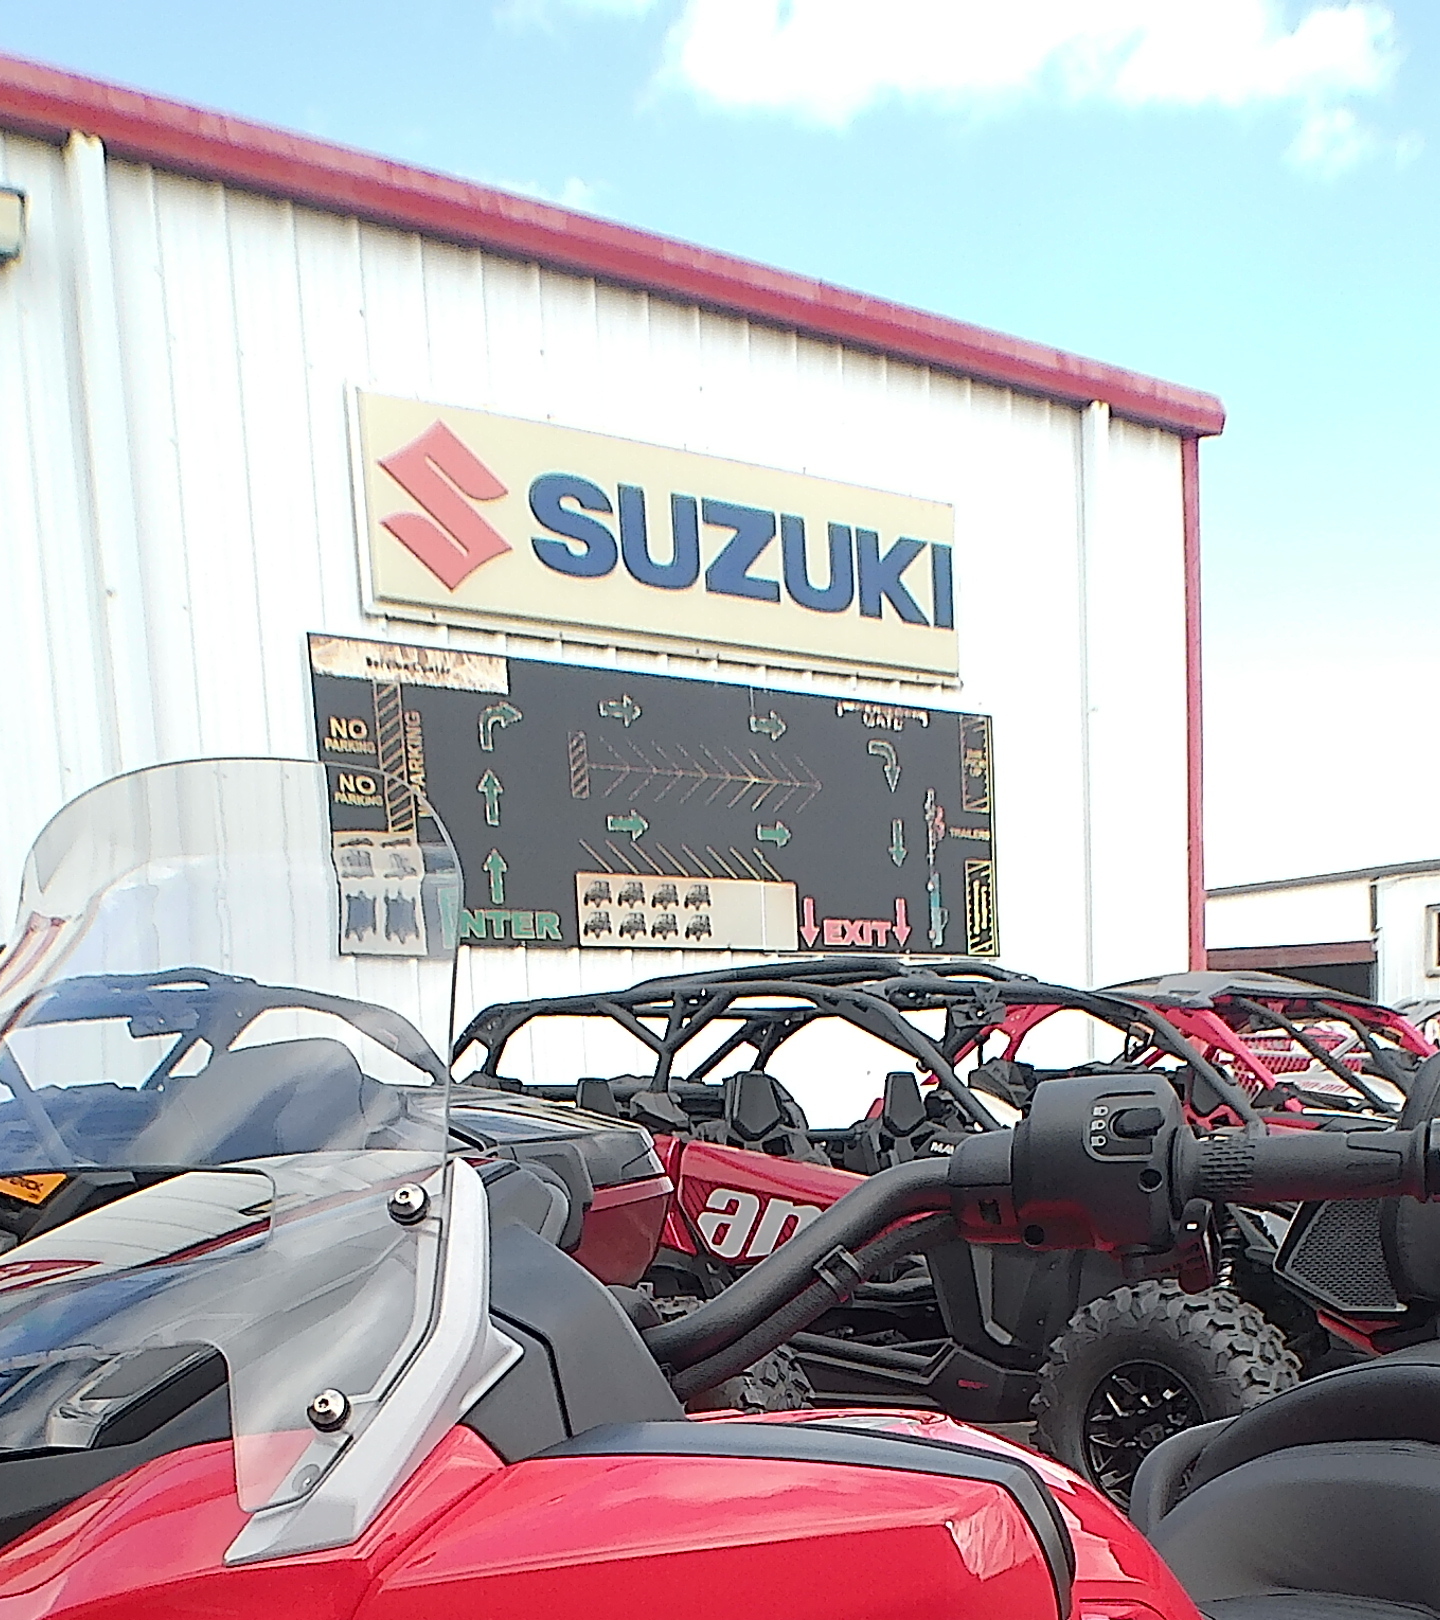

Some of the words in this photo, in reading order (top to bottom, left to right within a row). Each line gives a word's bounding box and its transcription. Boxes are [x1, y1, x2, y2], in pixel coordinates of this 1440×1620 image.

[526, 472, 954, 630] SUZUKI
[329, 716, 368, 740] NO
[403, 711, 427, 792] PARKING
[339, 773, 377, 794] NO
[823, 918, 894, 948] EXIT
